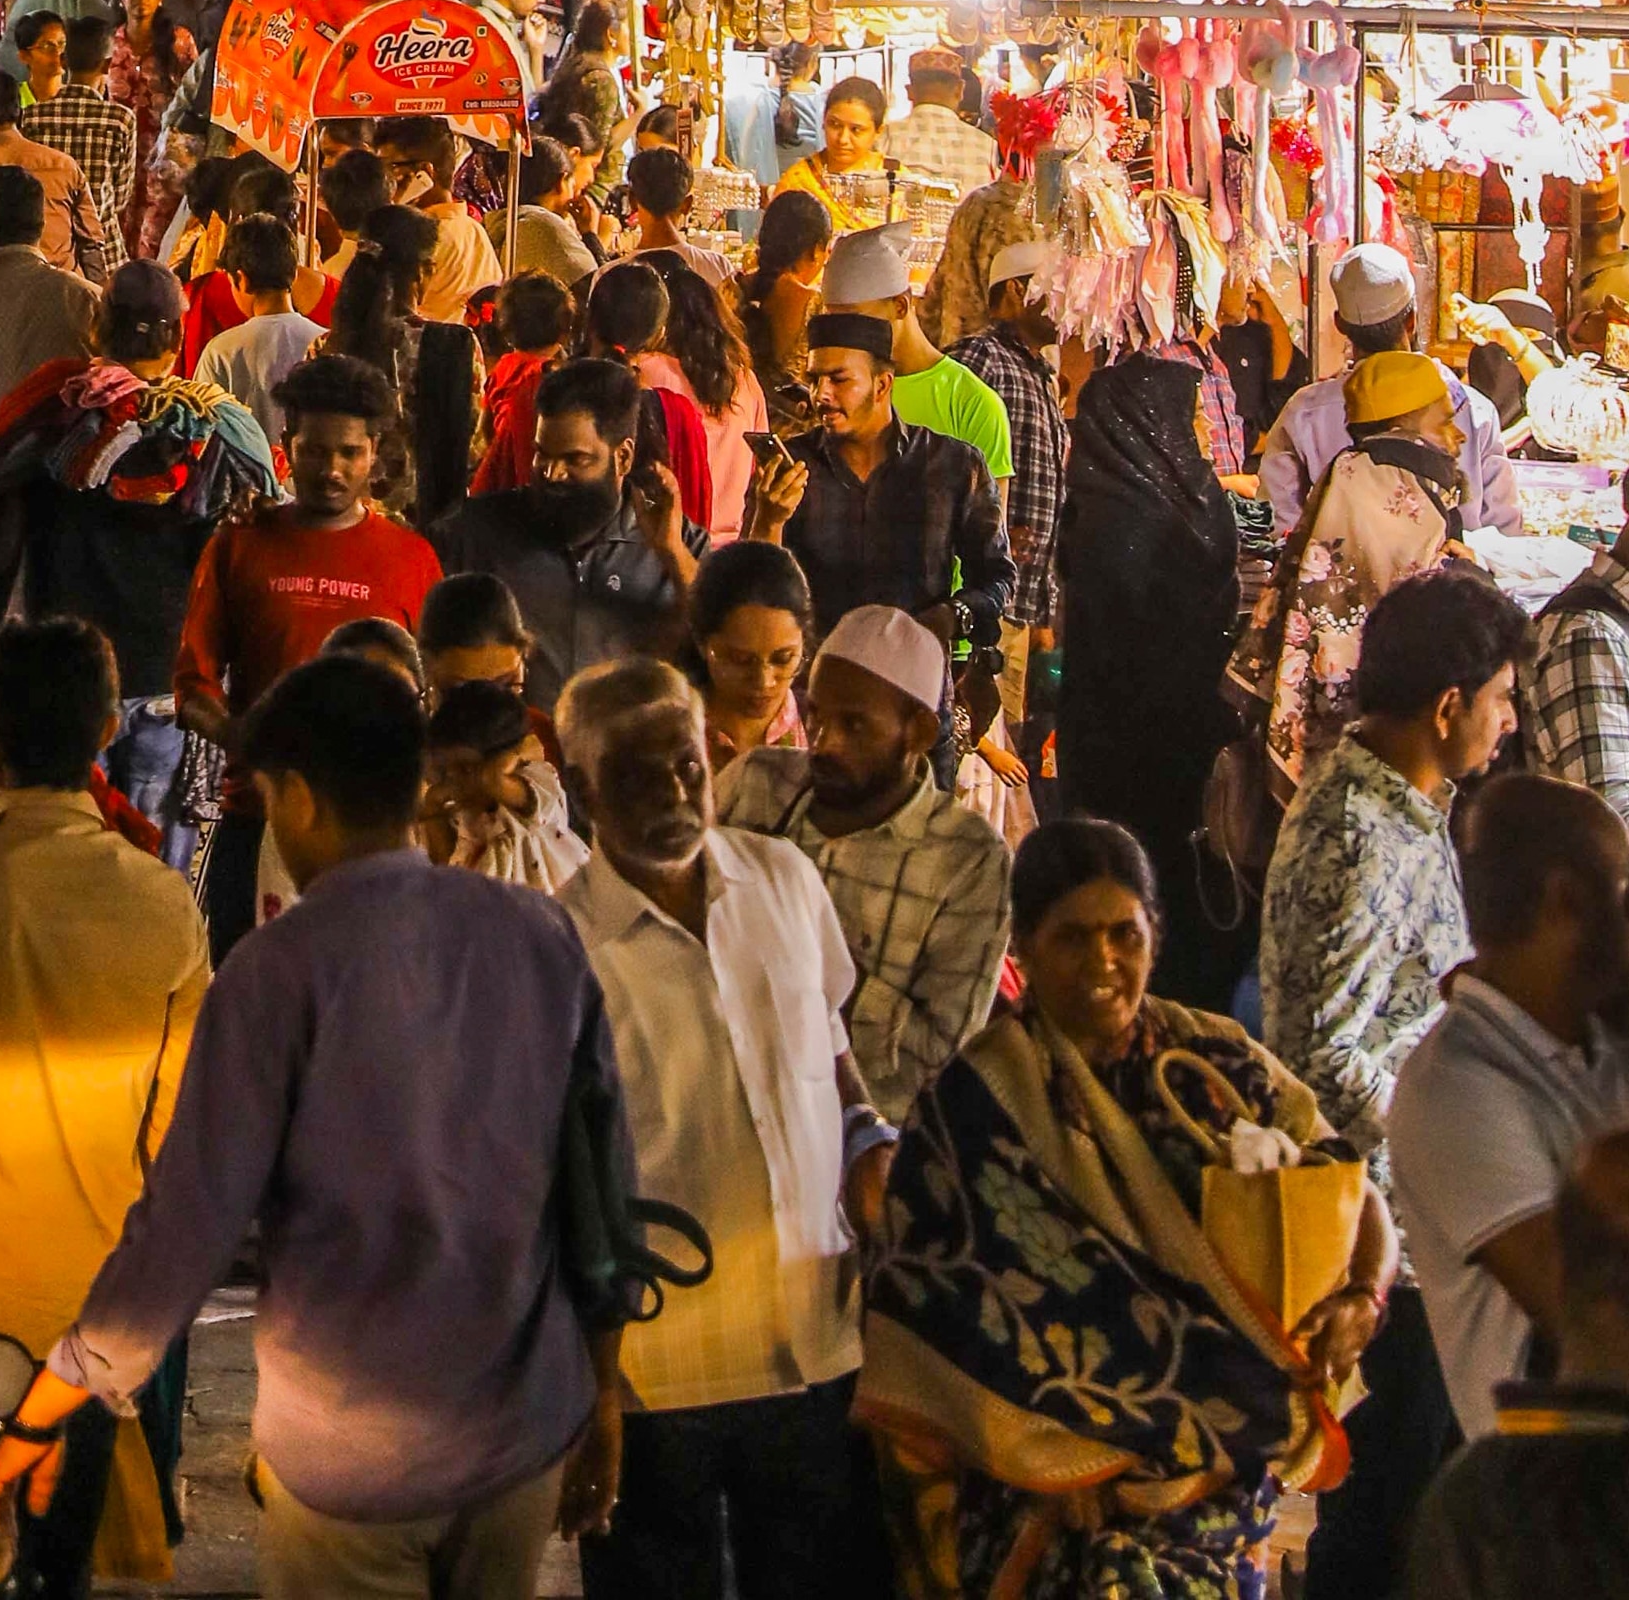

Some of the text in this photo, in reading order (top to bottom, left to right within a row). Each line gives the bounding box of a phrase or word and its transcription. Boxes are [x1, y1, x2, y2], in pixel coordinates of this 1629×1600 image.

[375, 33, 473, 68] Heera
[394, 64, 455, 77] ICE CREAM
[397, 101, 443, 110] SINCE 1971
[268, 577, 370, 600] YOUNG POWER
